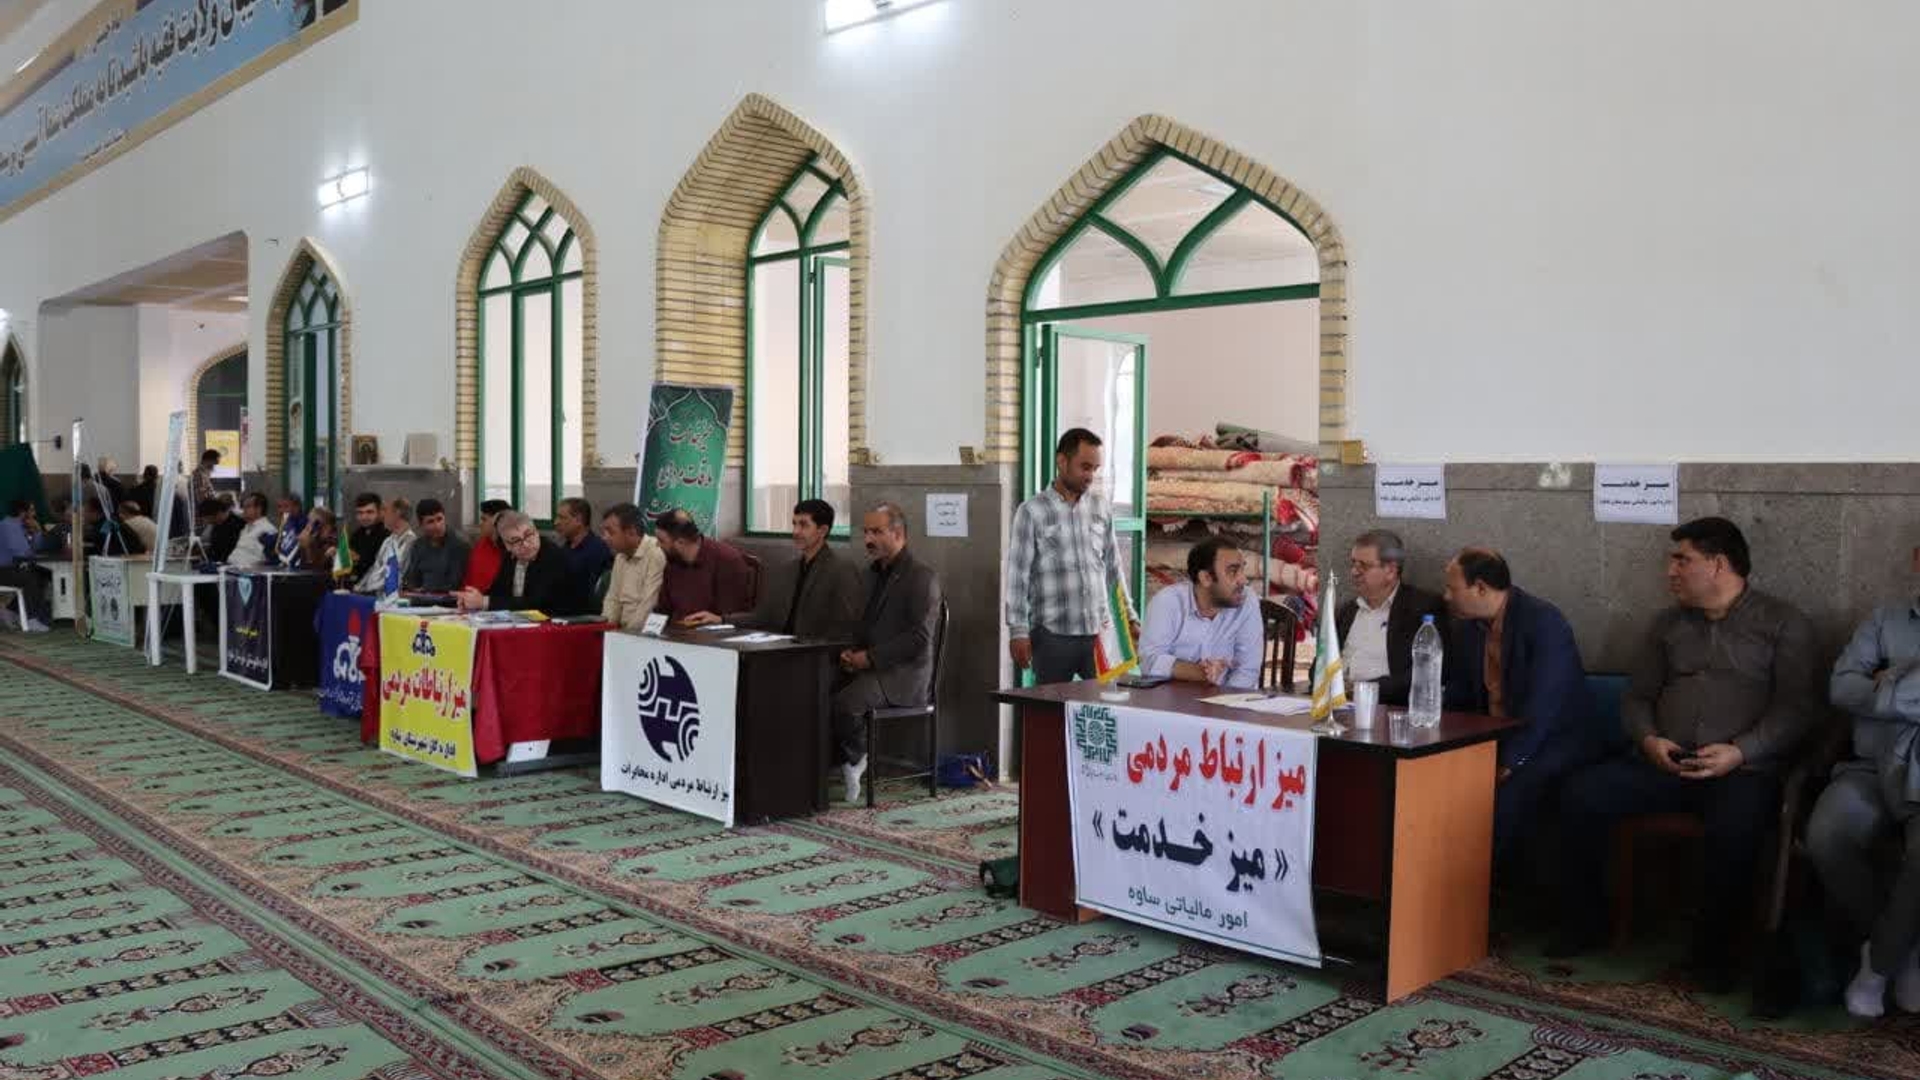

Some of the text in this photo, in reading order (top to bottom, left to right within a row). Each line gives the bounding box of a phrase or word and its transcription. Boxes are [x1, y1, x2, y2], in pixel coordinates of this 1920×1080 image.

[382, 670, 411, 706] مردمی
[620, 763, 650, 780] مخابرات
[650, 770, 669, 785] اداره
[669, 779, 694, 794] مردمی
[1126, 729, 1306, 810] میز ارتباط مردمی
[696, 778, 718, 800] ارتباط
[1112, 809, 1214, 866] خدمت
[1226, 830, 1266, 892] میز
[1128, 885, 1249, 930] امور مالیاتی ساوه
